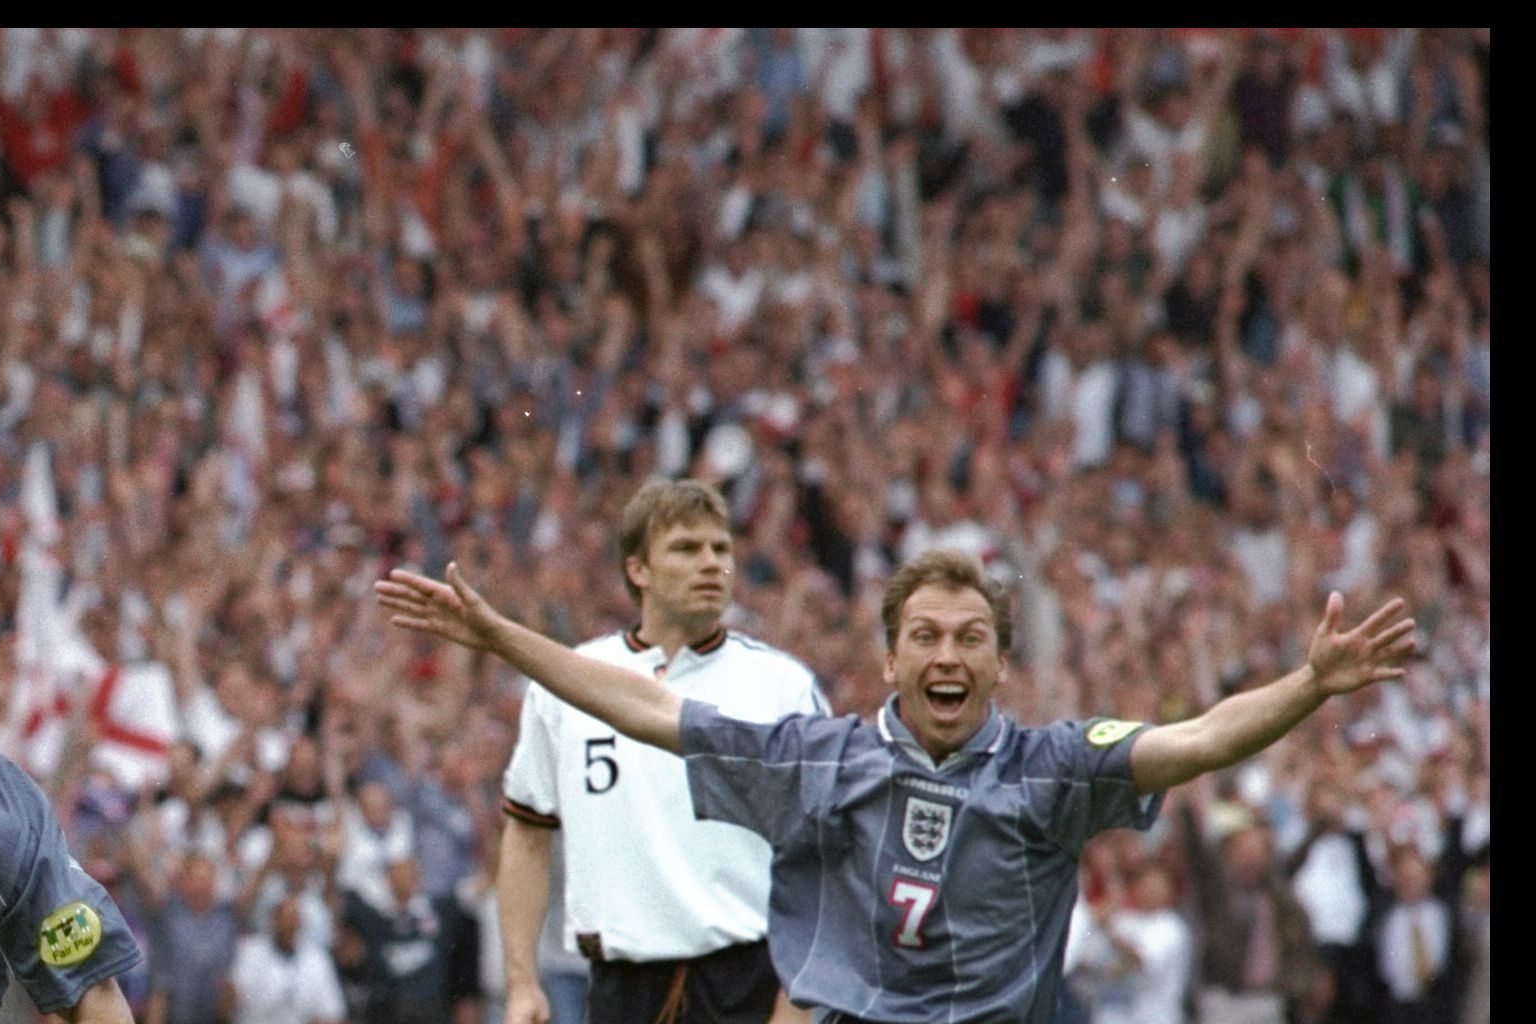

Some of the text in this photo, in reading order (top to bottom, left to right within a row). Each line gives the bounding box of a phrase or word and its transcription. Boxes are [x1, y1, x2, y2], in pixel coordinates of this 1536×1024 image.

[585, 735, 619, 795] 5
[889, 875, 939, 950] 7
[52, 935, 94, 962] Fair Play
